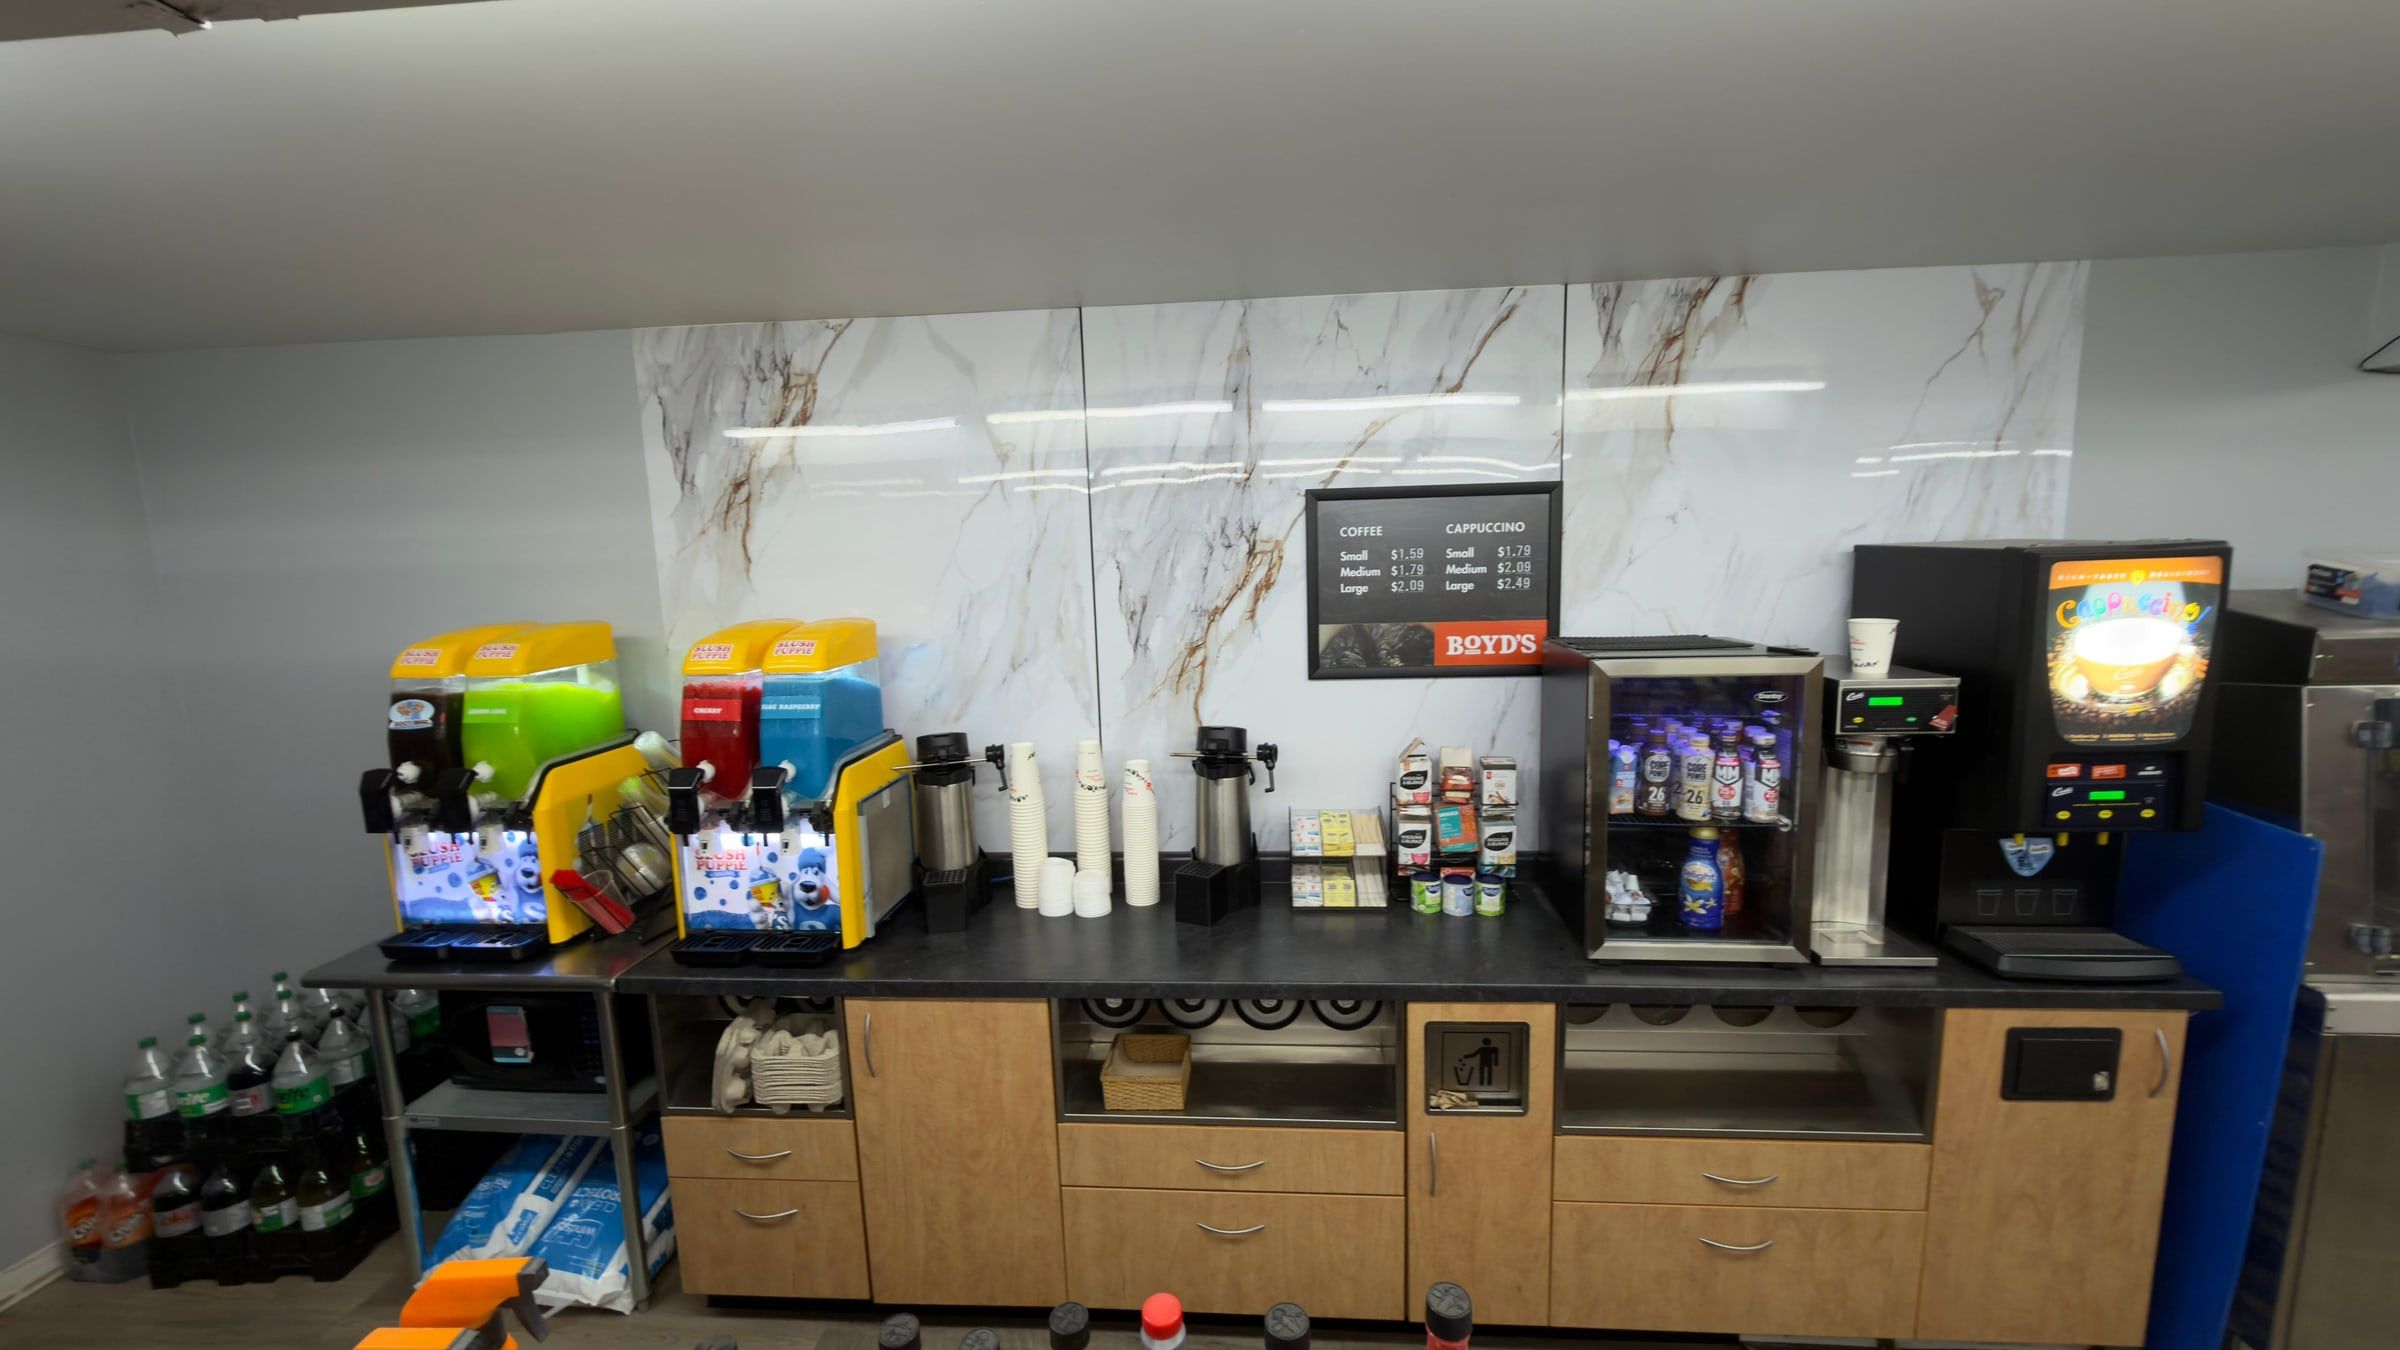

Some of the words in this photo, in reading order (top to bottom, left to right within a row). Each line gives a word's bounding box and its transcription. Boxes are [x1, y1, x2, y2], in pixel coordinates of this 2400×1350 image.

[1339, 525, 1383, 537] COFFEE
[1446, 521, 1525, 534] CAPPUCCINO
[1340, 550, 1368, 561] Small
[1391, 548, 1424, 560] $1.59
[1446, 547, 1474, 559] Small
[1497, 545, 1531, 557] $1.79
[1340, 566, 1381, 577] Medium
[1391, 564, 1424, 576] $1.79
[1446, 563, 1487, 575] Medium
[1497, 561, 1531, 574] $2.09
[1340, 583, 1369, 595] Large
[1391, 580, 1424, 592] $2.09
[1446, 580, 1475, 592] Large
[1497, 577, 1531, 590] $2.49
[694, 644, 733, 652] SLUSH
[776, 640, 817, 648] SLUSH
[1446, 633, 1537, 655] BOYD'S
[691, 652, 730, 660] PUPPIE
[774, 647, 814, 655] PUPPIE
[1650, 761, 1670, 770] CORE
[1687, 763, 1708, 772] CORE
[1649, 770, 1668, 778] POWER
[1687, 772, 1707, 780] POWER
[1648, 787, 1666, 802] 26
[1687, 789, 1704, 804] 26
[411, 855, 463, 867] PUPPIE
[696, 860, 747, 871] PUPPIE
